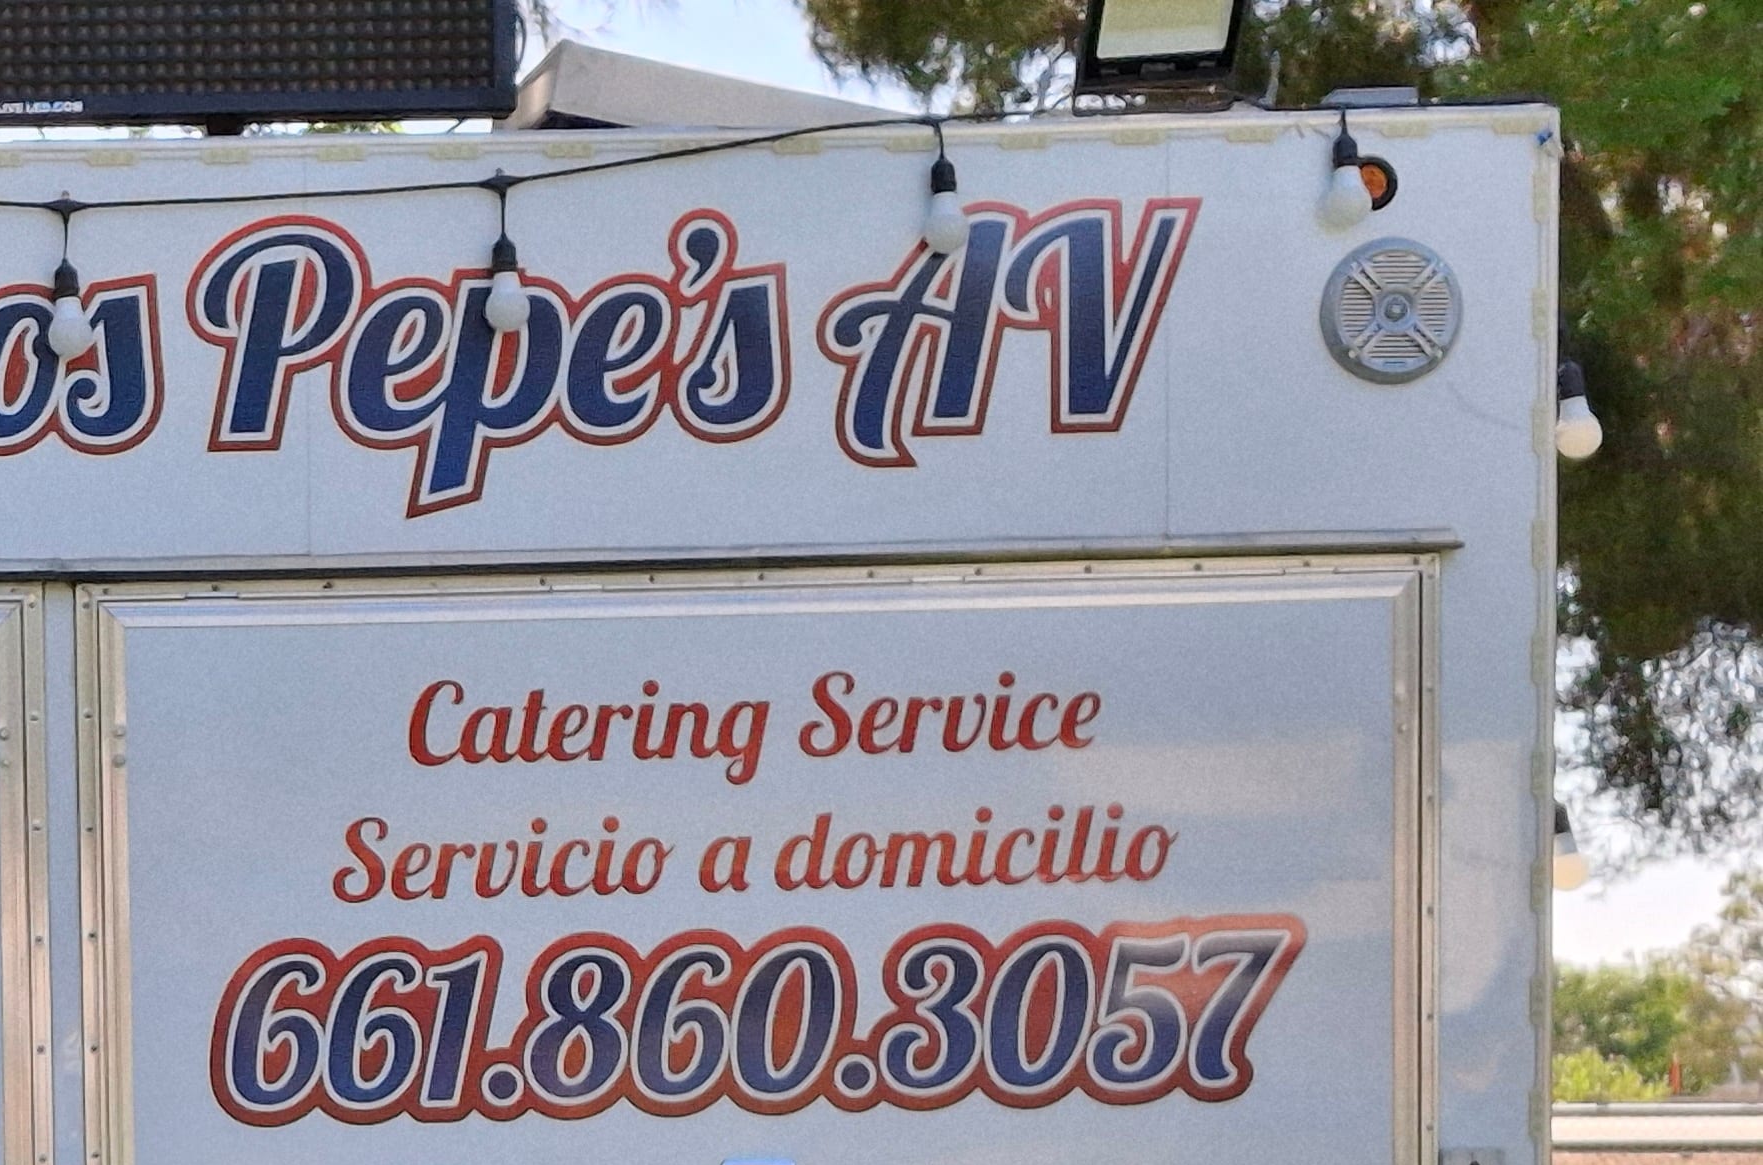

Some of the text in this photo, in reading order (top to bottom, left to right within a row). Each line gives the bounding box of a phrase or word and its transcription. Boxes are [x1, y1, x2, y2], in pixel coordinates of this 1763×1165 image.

[186, 208, 788, 519] Pepe's
[817, 197, 1202, 467] AV
[408, 671, 1101, 785] Catering Service
[333, 804, 1179, 903] Servicio a domicilio
[210, 912, 1307, 1128] 661.860.3057
